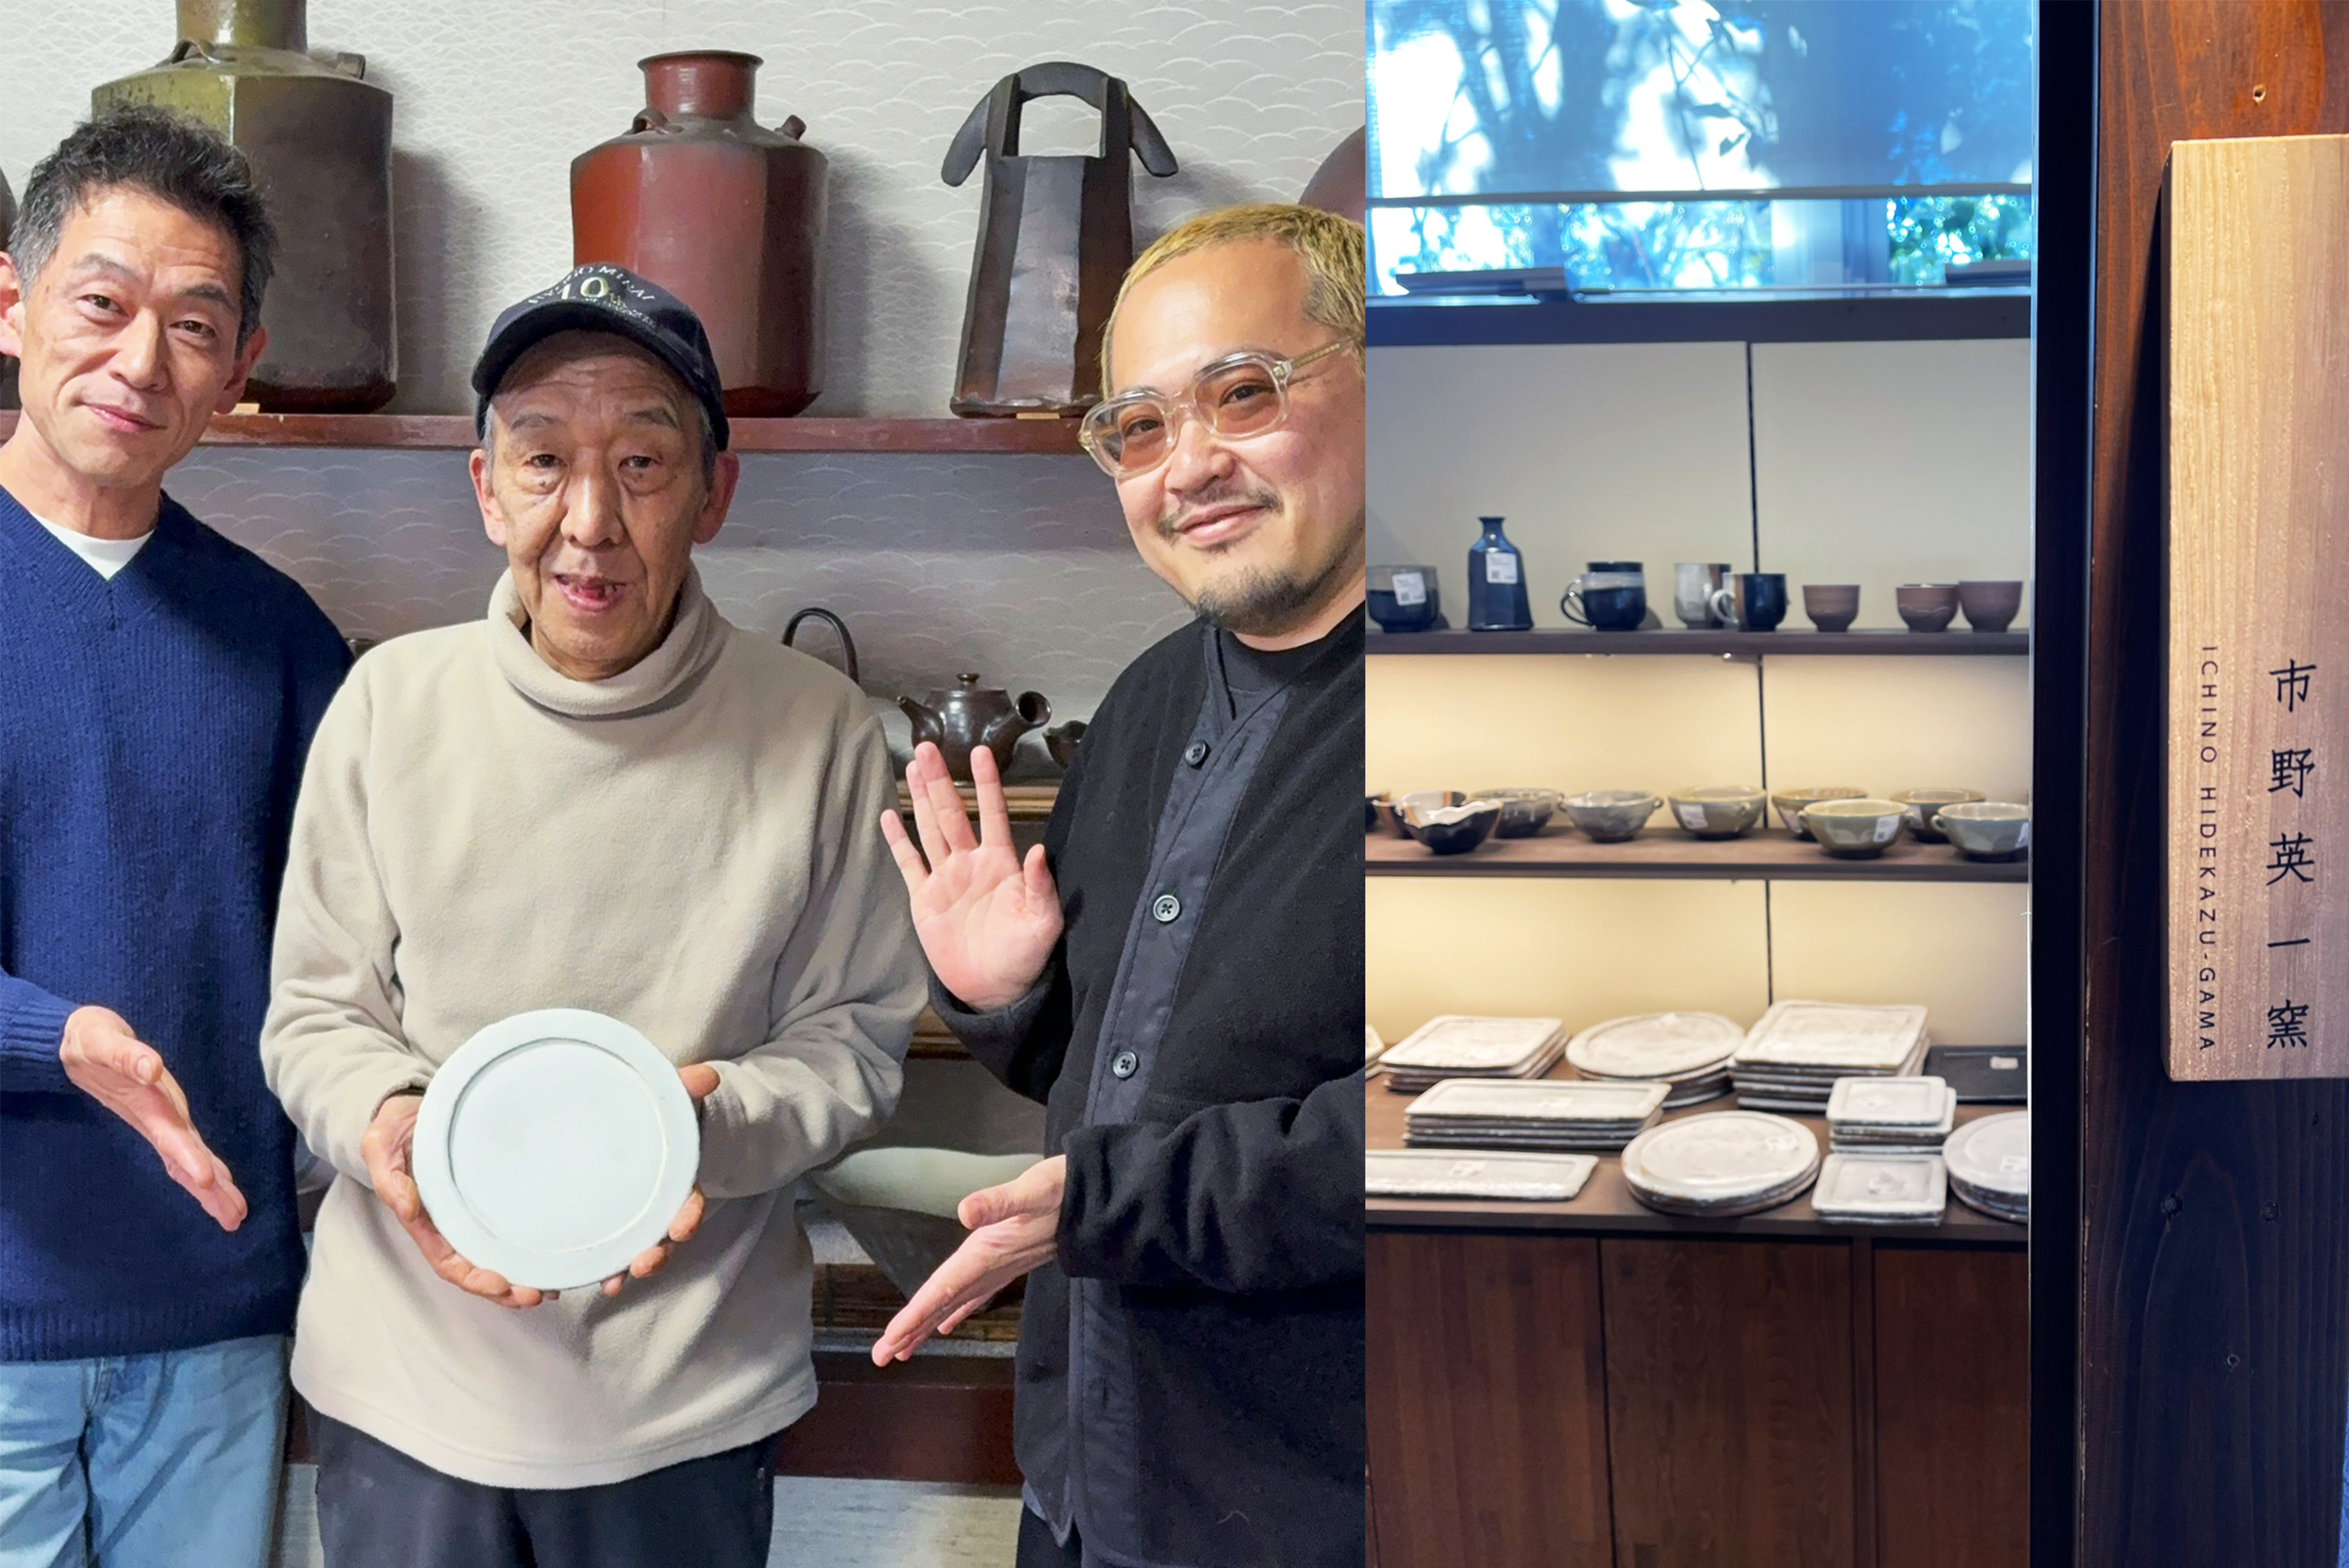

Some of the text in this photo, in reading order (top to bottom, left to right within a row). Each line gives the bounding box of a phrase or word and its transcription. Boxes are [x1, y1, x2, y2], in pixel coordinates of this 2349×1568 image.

[2199, 645, 2219, 1051] ICHINO HIDEKAZU-GAMA
[2266, 658, 2318, 1050] 市野英一窯
